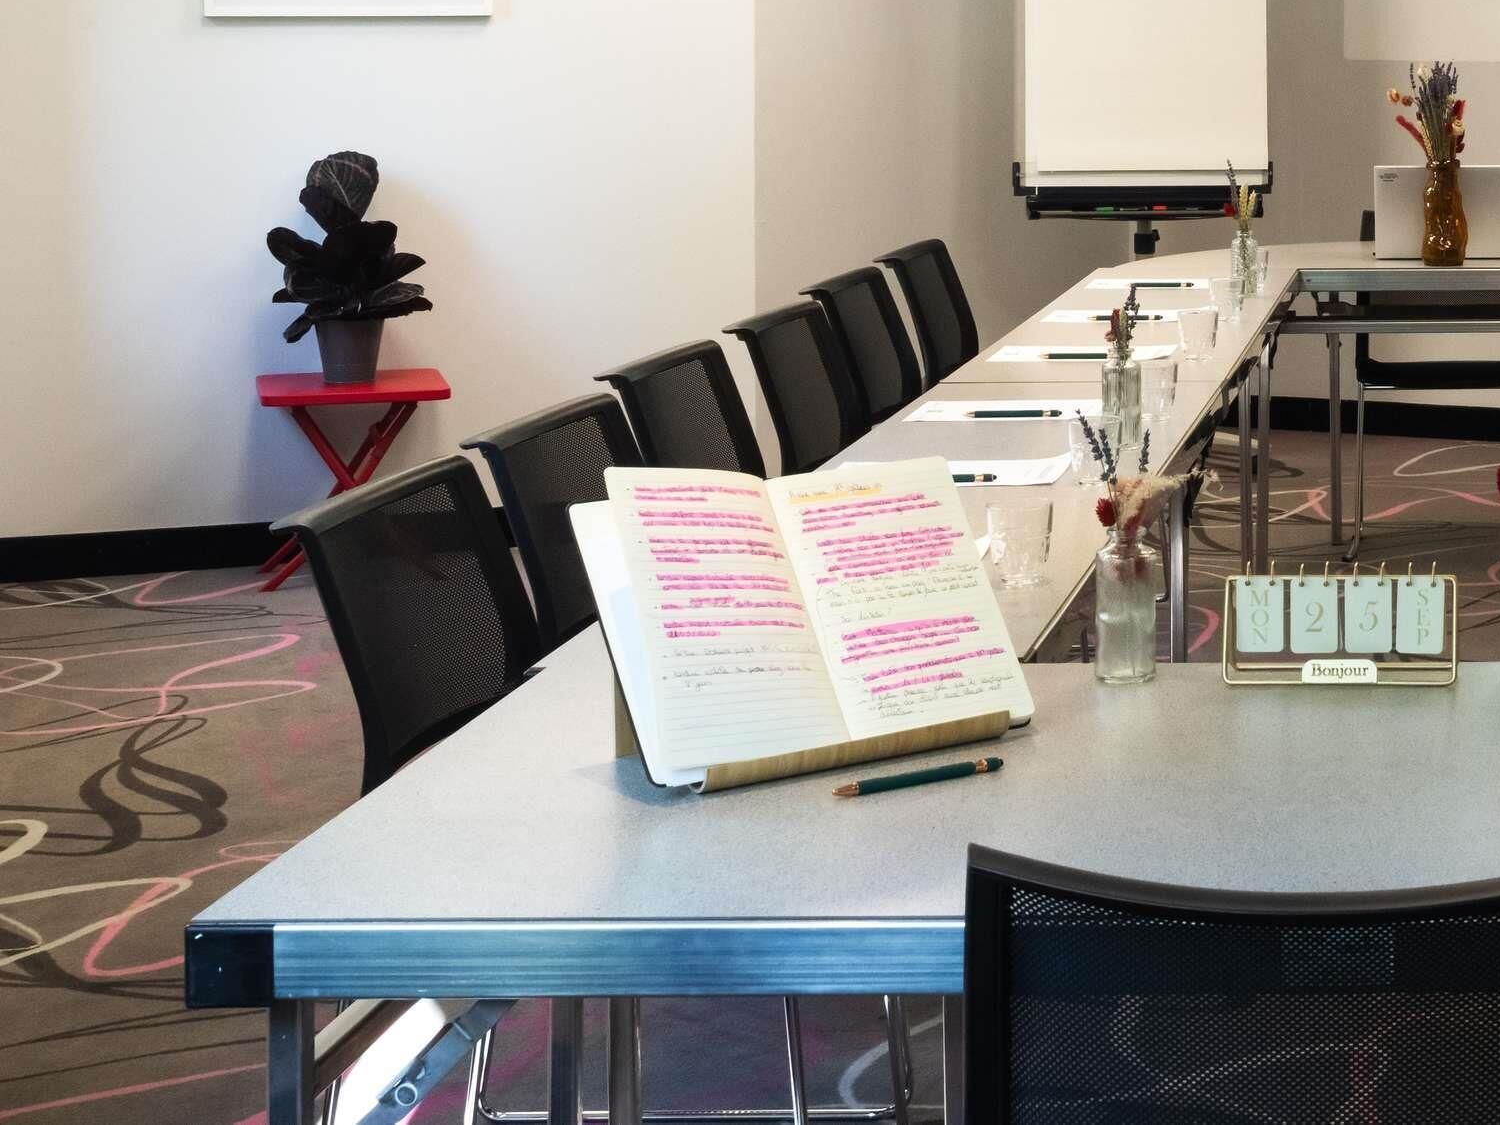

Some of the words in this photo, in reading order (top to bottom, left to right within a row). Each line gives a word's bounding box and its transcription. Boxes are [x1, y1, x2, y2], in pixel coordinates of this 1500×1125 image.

[1249, 589, 1270, 645] MON
[1417, 588, 1430, 645] SEP
[1312, 663, 1369, 679] Bonjour
